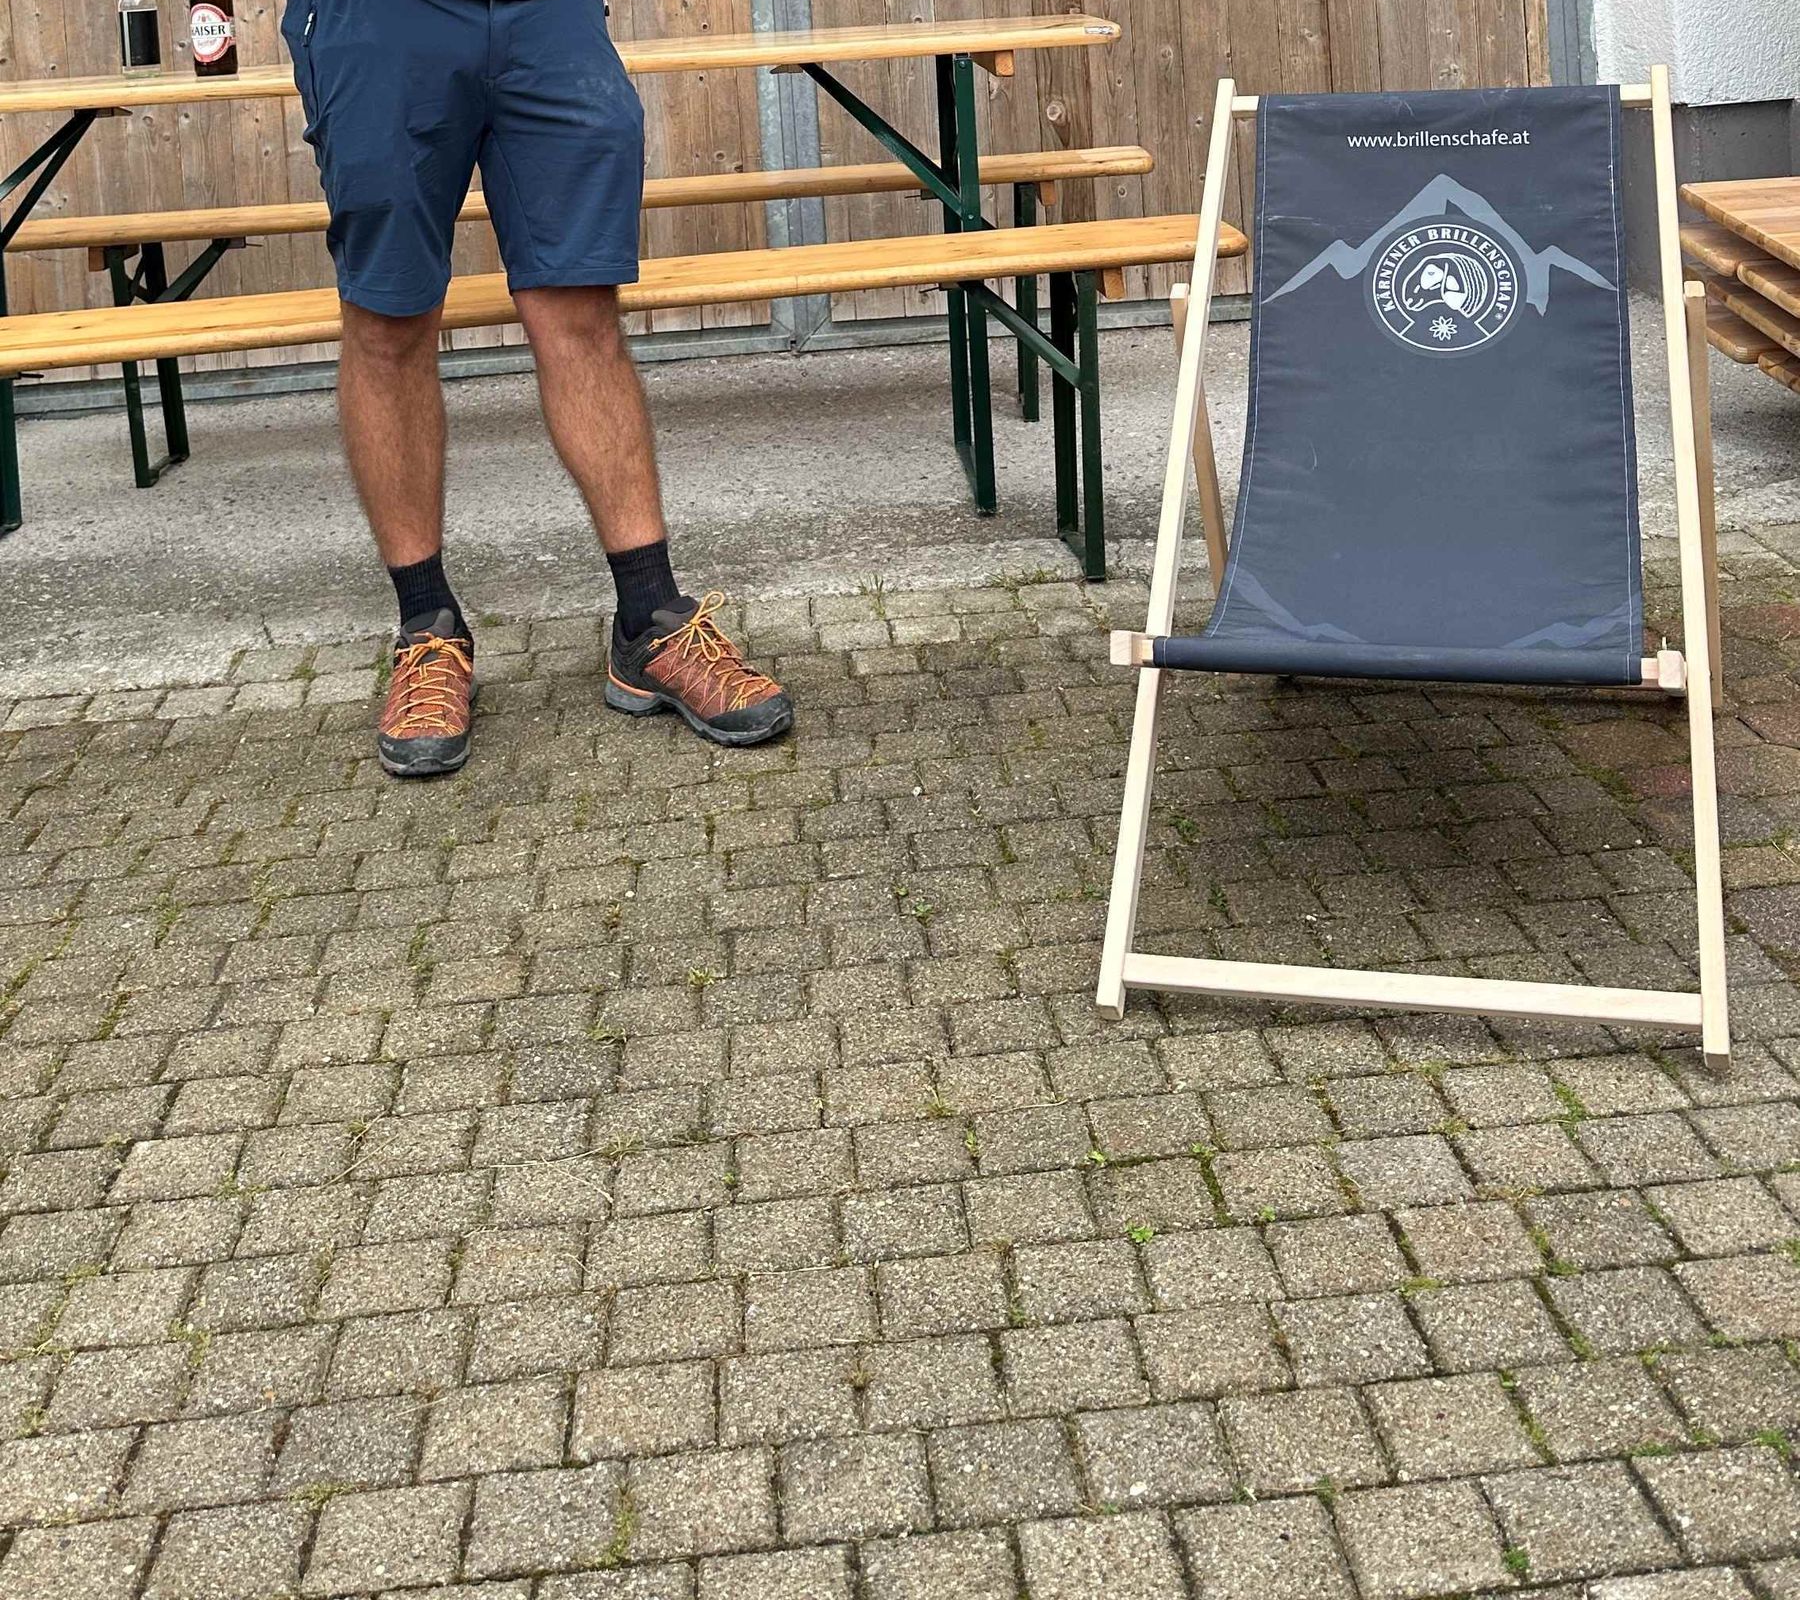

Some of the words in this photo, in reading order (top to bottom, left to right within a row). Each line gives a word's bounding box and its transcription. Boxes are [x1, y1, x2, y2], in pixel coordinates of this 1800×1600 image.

[1347, 128, 1530, 148] www.brillenschafe.at
[1376, 234, 1421, 312] KÄRNTNER
[1427, 227, 1512, 313] BRILLENSCHAF
